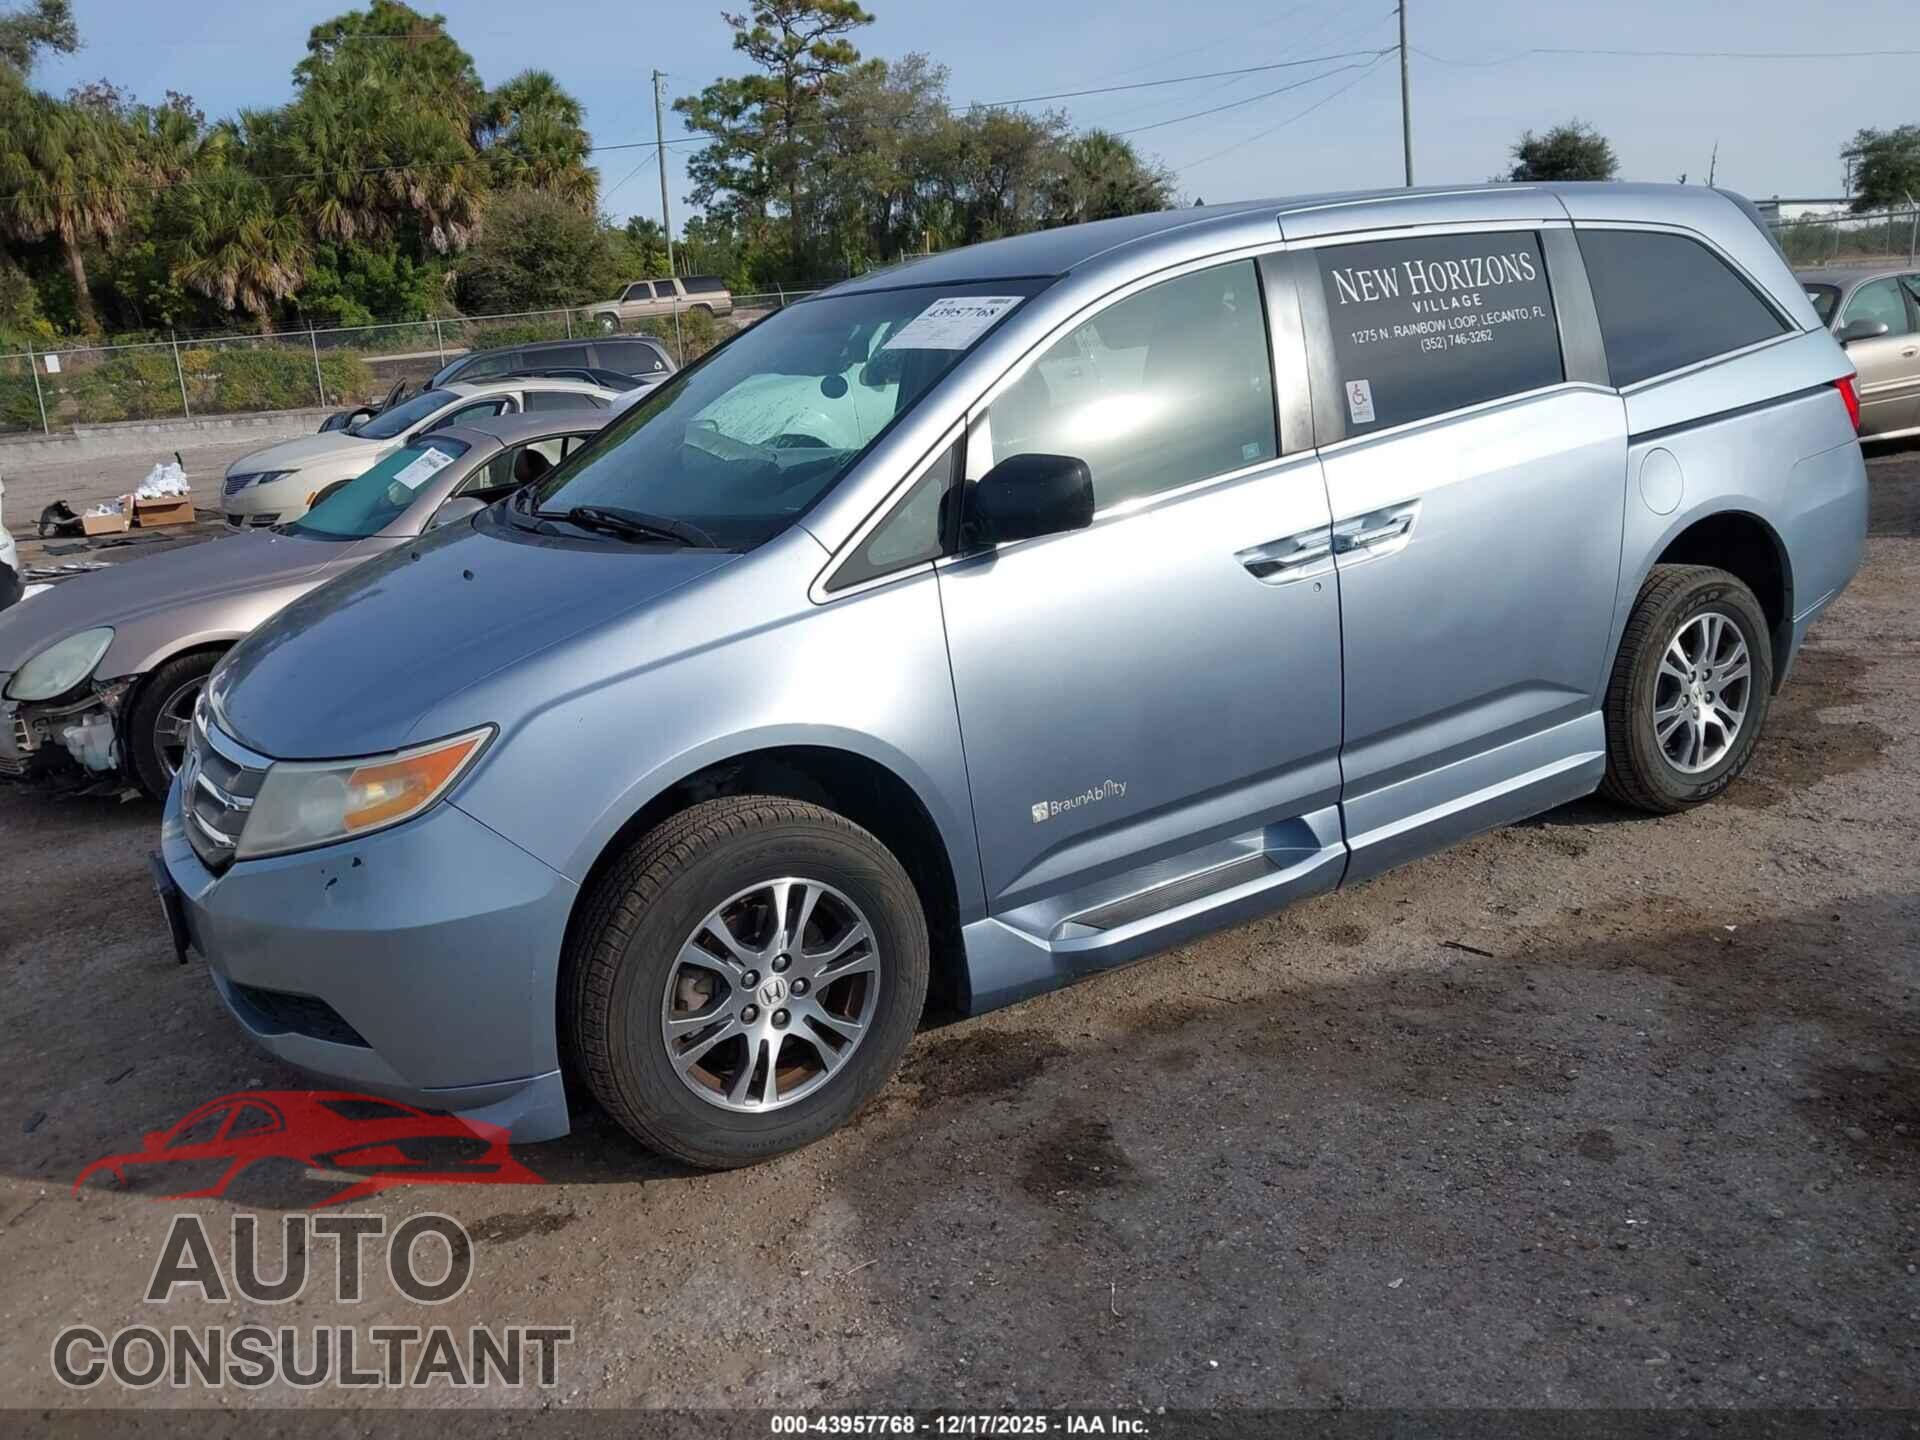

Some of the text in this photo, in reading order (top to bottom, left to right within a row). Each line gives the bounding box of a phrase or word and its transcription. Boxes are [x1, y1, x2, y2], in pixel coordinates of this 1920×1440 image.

[1332, 252, 1536, 305] NEW HORIZONS
[1412, 293, 1483, 313] VILLAGE
[1351, 330, 1378, 345] 1275
[1379, 328, 1392, 341] N.
[1393, 317, 1446, 337] RAINBOW
[1532, 306, 1546, 318] FL
[1420, 329, 1494, 353] (352) 746-3262
[1050, 779, 1127, 816] BraunAbility
